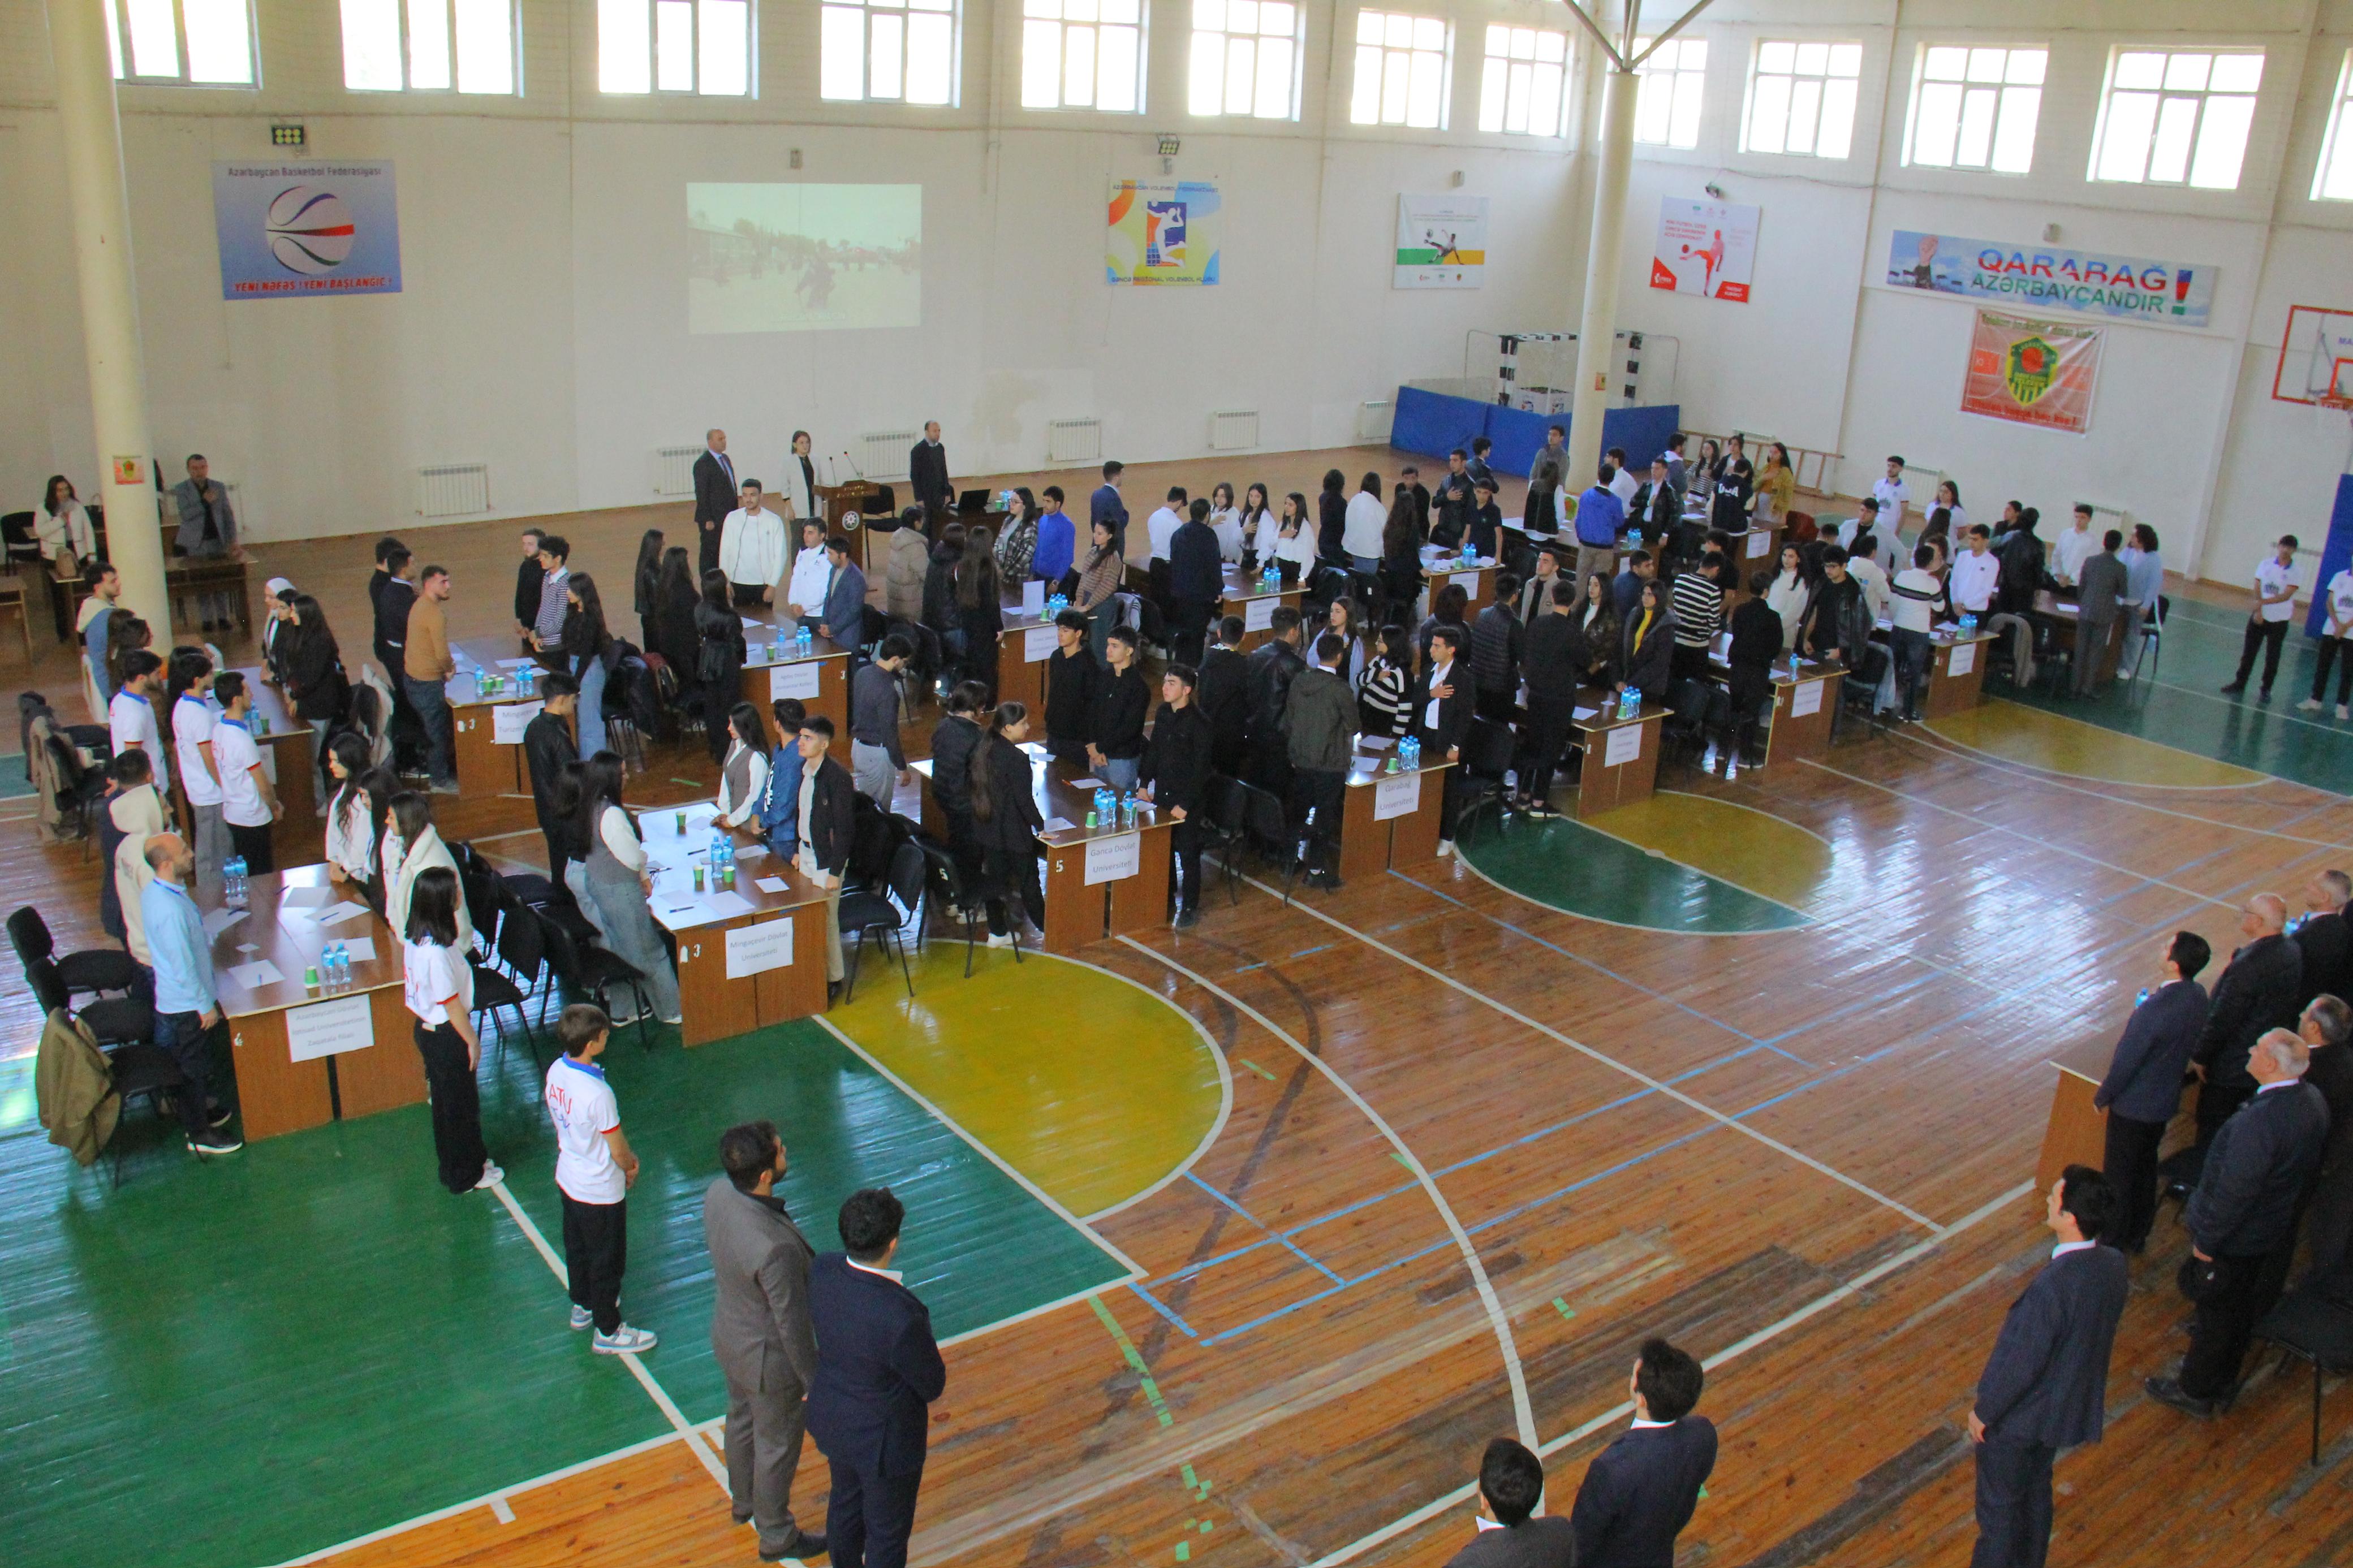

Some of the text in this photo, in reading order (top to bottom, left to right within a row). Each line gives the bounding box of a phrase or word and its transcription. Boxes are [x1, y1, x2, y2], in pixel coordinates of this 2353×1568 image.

[1977, 248, 2167, 291] QARABAĞ
[1971, 273, 2165, 313] AZƏRBAYCANDIR
[1380, 797, 1413, 810] Universiteti
[1114, 842, 1136, 852] Dövlət
[1055, 859, 1064, 873] 5
[1092, 859, 1132, 873] Universiteti
[768, 931, 788, 941] Dövlət
[693, 943, 702, 958] 3
[741, 948, 778, 961] Universiteti
[549, 1083, 572, 1115] ATU
